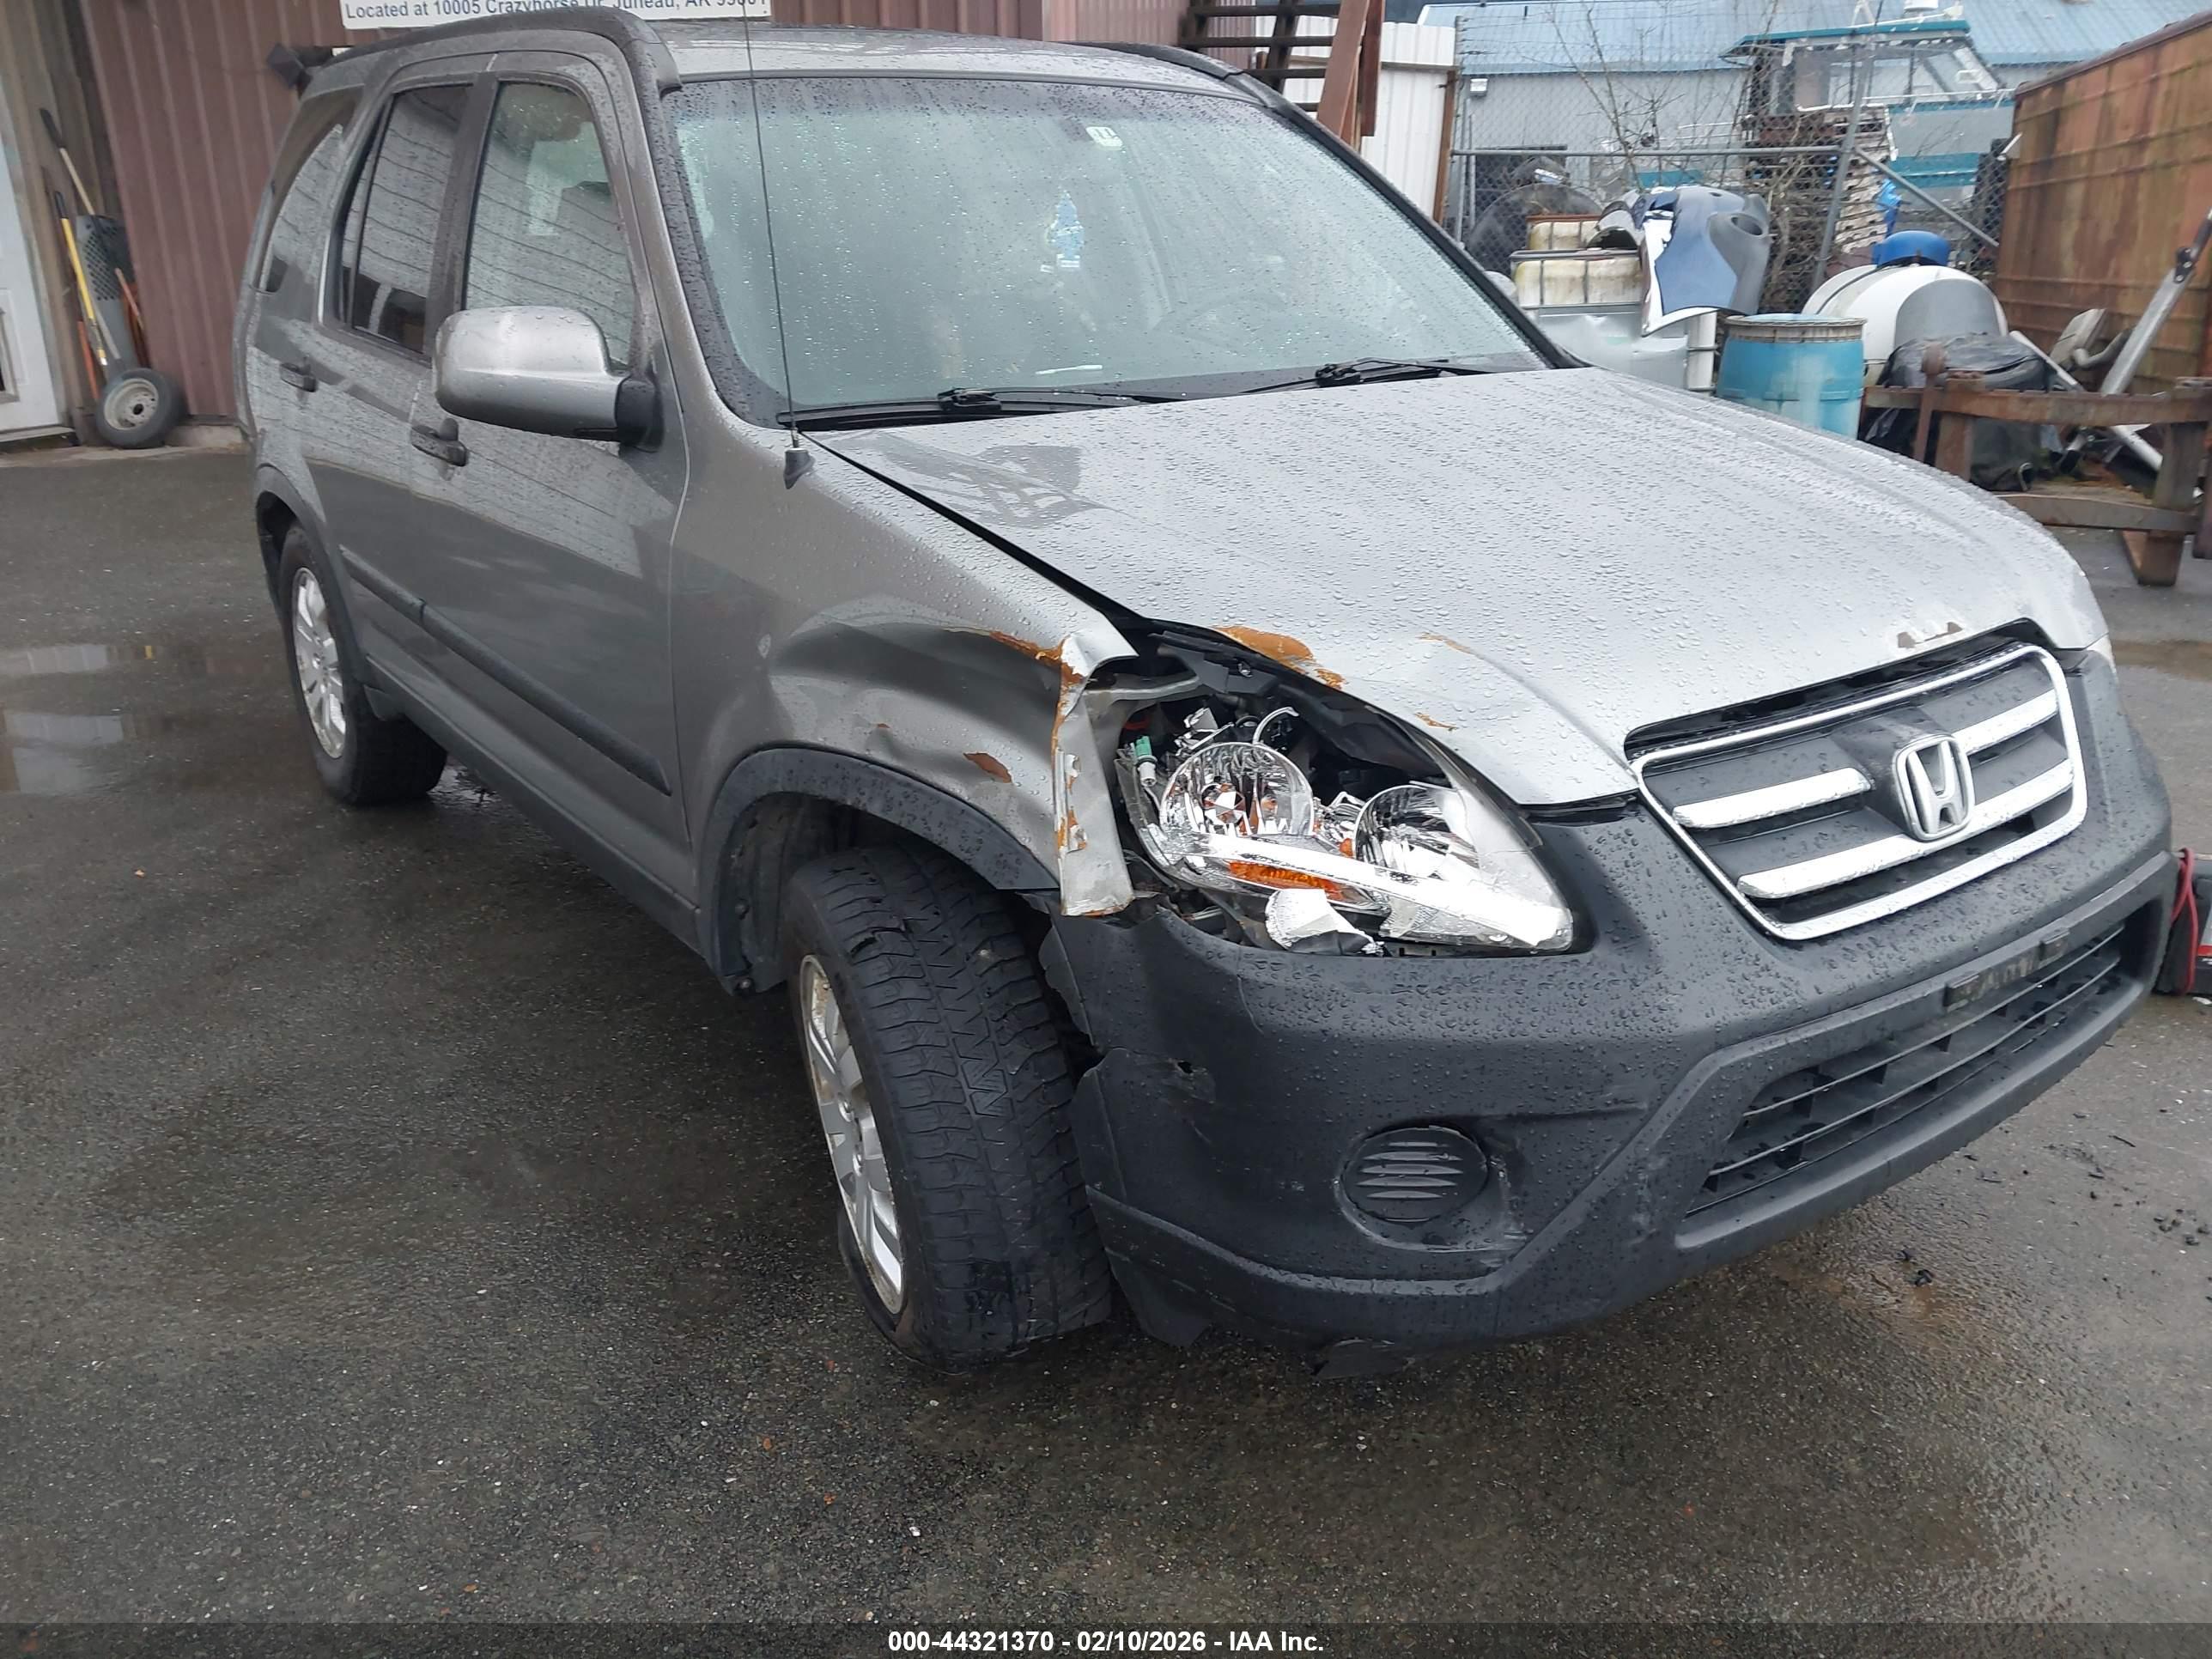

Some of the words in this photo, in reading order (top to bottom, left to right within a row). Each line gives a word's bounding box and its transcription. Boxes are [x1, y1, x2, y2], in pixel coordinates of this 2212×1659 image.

[344, 2, 409, 18] Located
[414, 2, 428, 15] at
[434, 0, 480, 15] 10005
